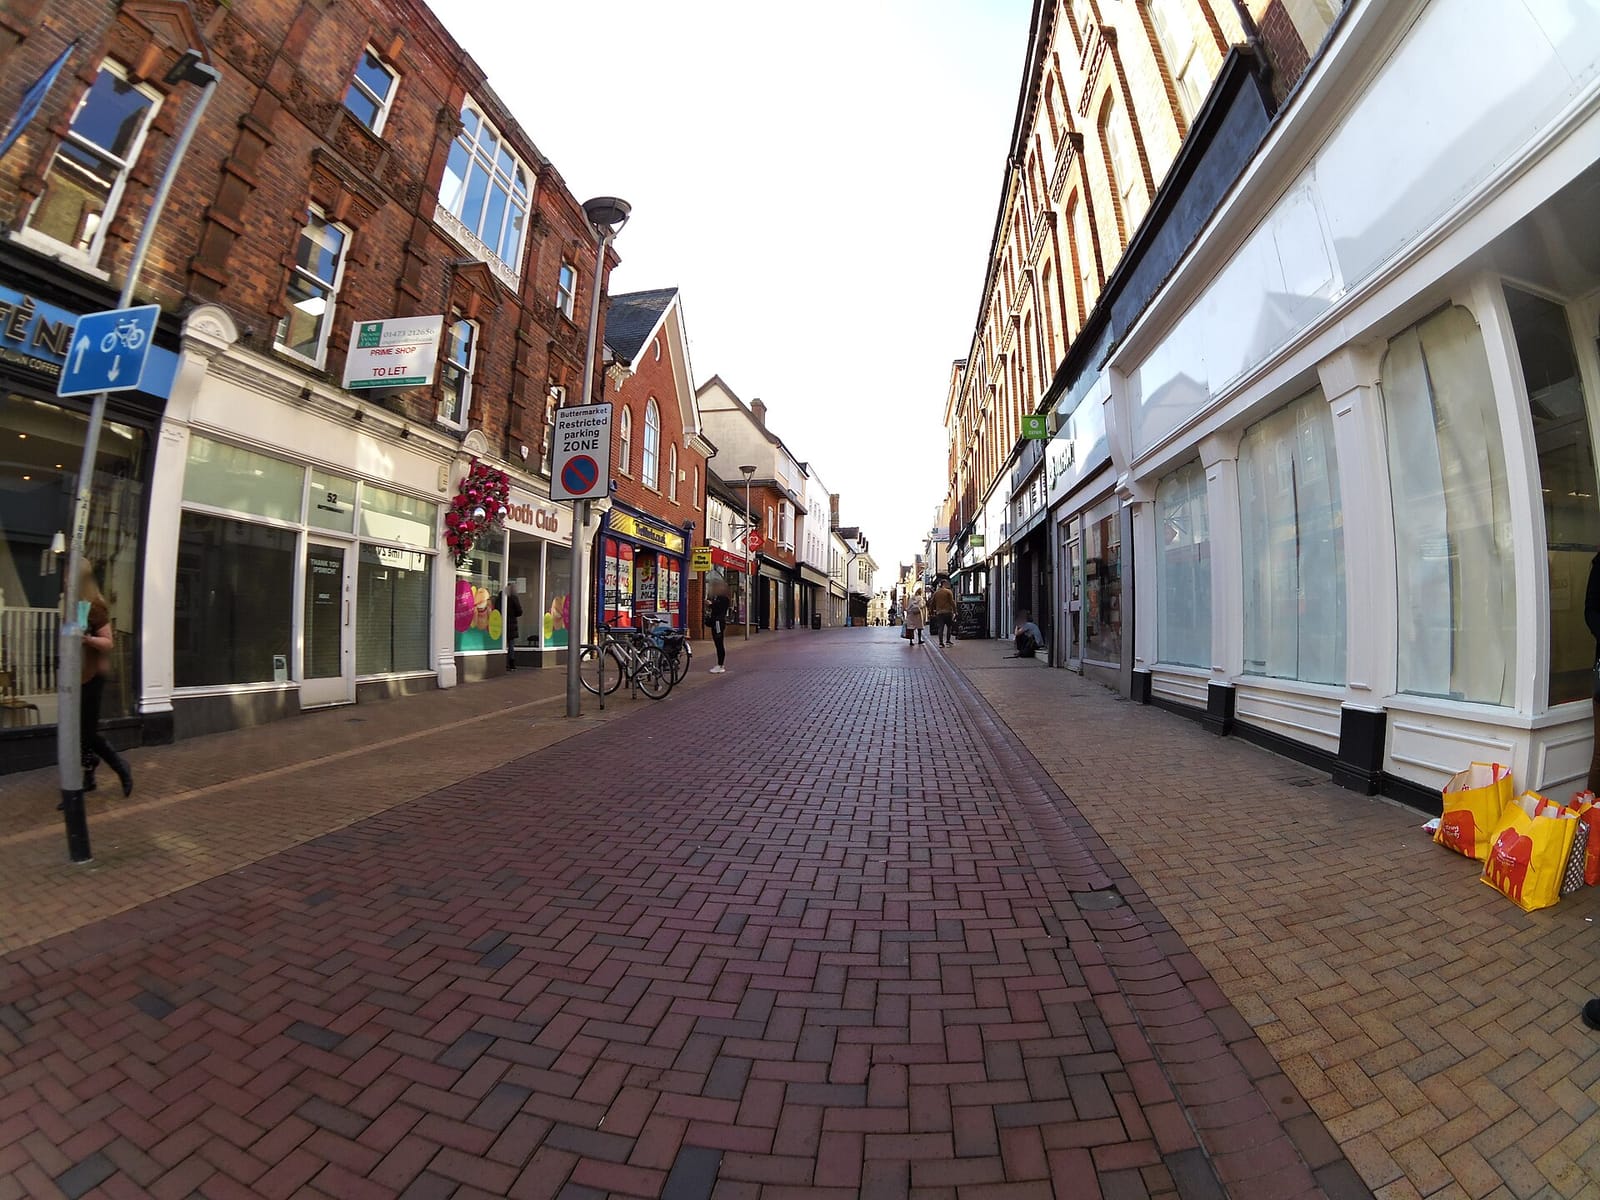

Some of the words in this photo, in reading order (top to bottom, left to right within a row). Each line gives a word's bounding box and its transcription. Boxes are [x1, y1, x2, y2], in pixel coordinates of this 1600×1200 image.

[370, 348, 393, 357] PRIME
[394, 346, 417, 355] SHOP
[372, 367, 386, 377] TO
[387, 366, 408, 376] LET
[560, 407, 608, 419] Buttermarket
[559, 416, 608, 430] Restricted
[564, 429, 600, 440] parking
[563, 439, 600, 452] ZONE
[327, 492, 338, 504] 52
[535, 508, 559, 533] Club
